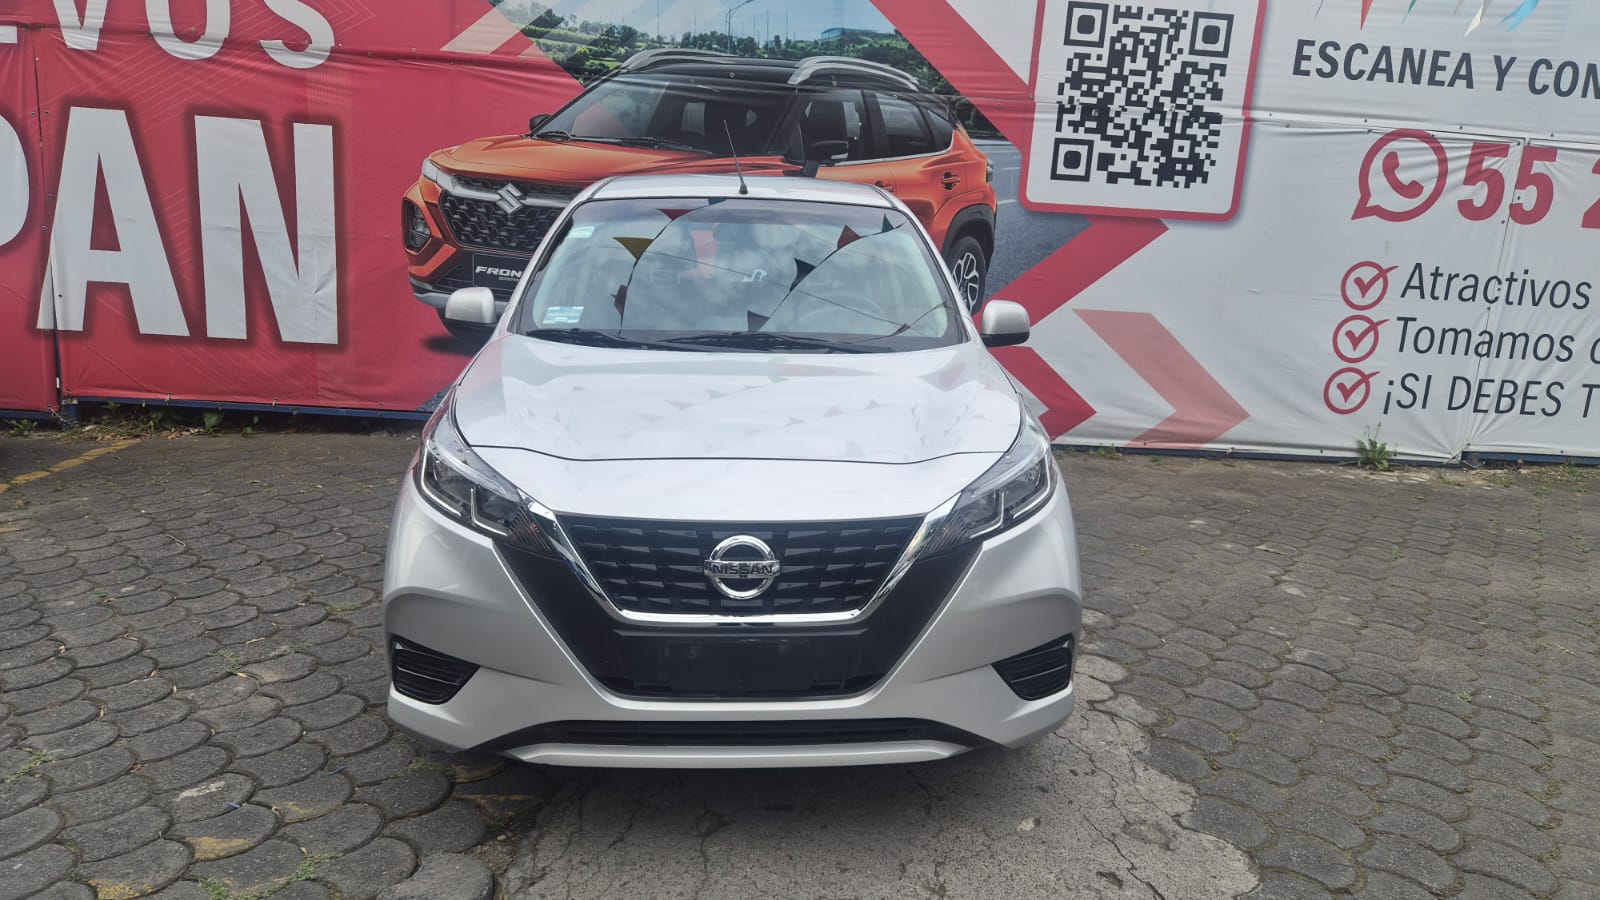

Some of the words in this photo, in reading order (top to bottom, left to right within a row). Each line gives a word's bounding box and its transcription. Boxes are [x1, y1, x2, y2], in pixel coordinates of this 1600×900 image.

[1292, 39, 1474, 90] ESCANEA
[1493, 54, 1517, 92] Y
[1400, 262, 1592, 310] Atractivos
[1396, 316, 1575, 363] Tomamos
[1383, 372, 1432, 415] ¡SI
[1447, 375, 1565, 418] DEBES
[711, 564, 774, 576] NISSAN
